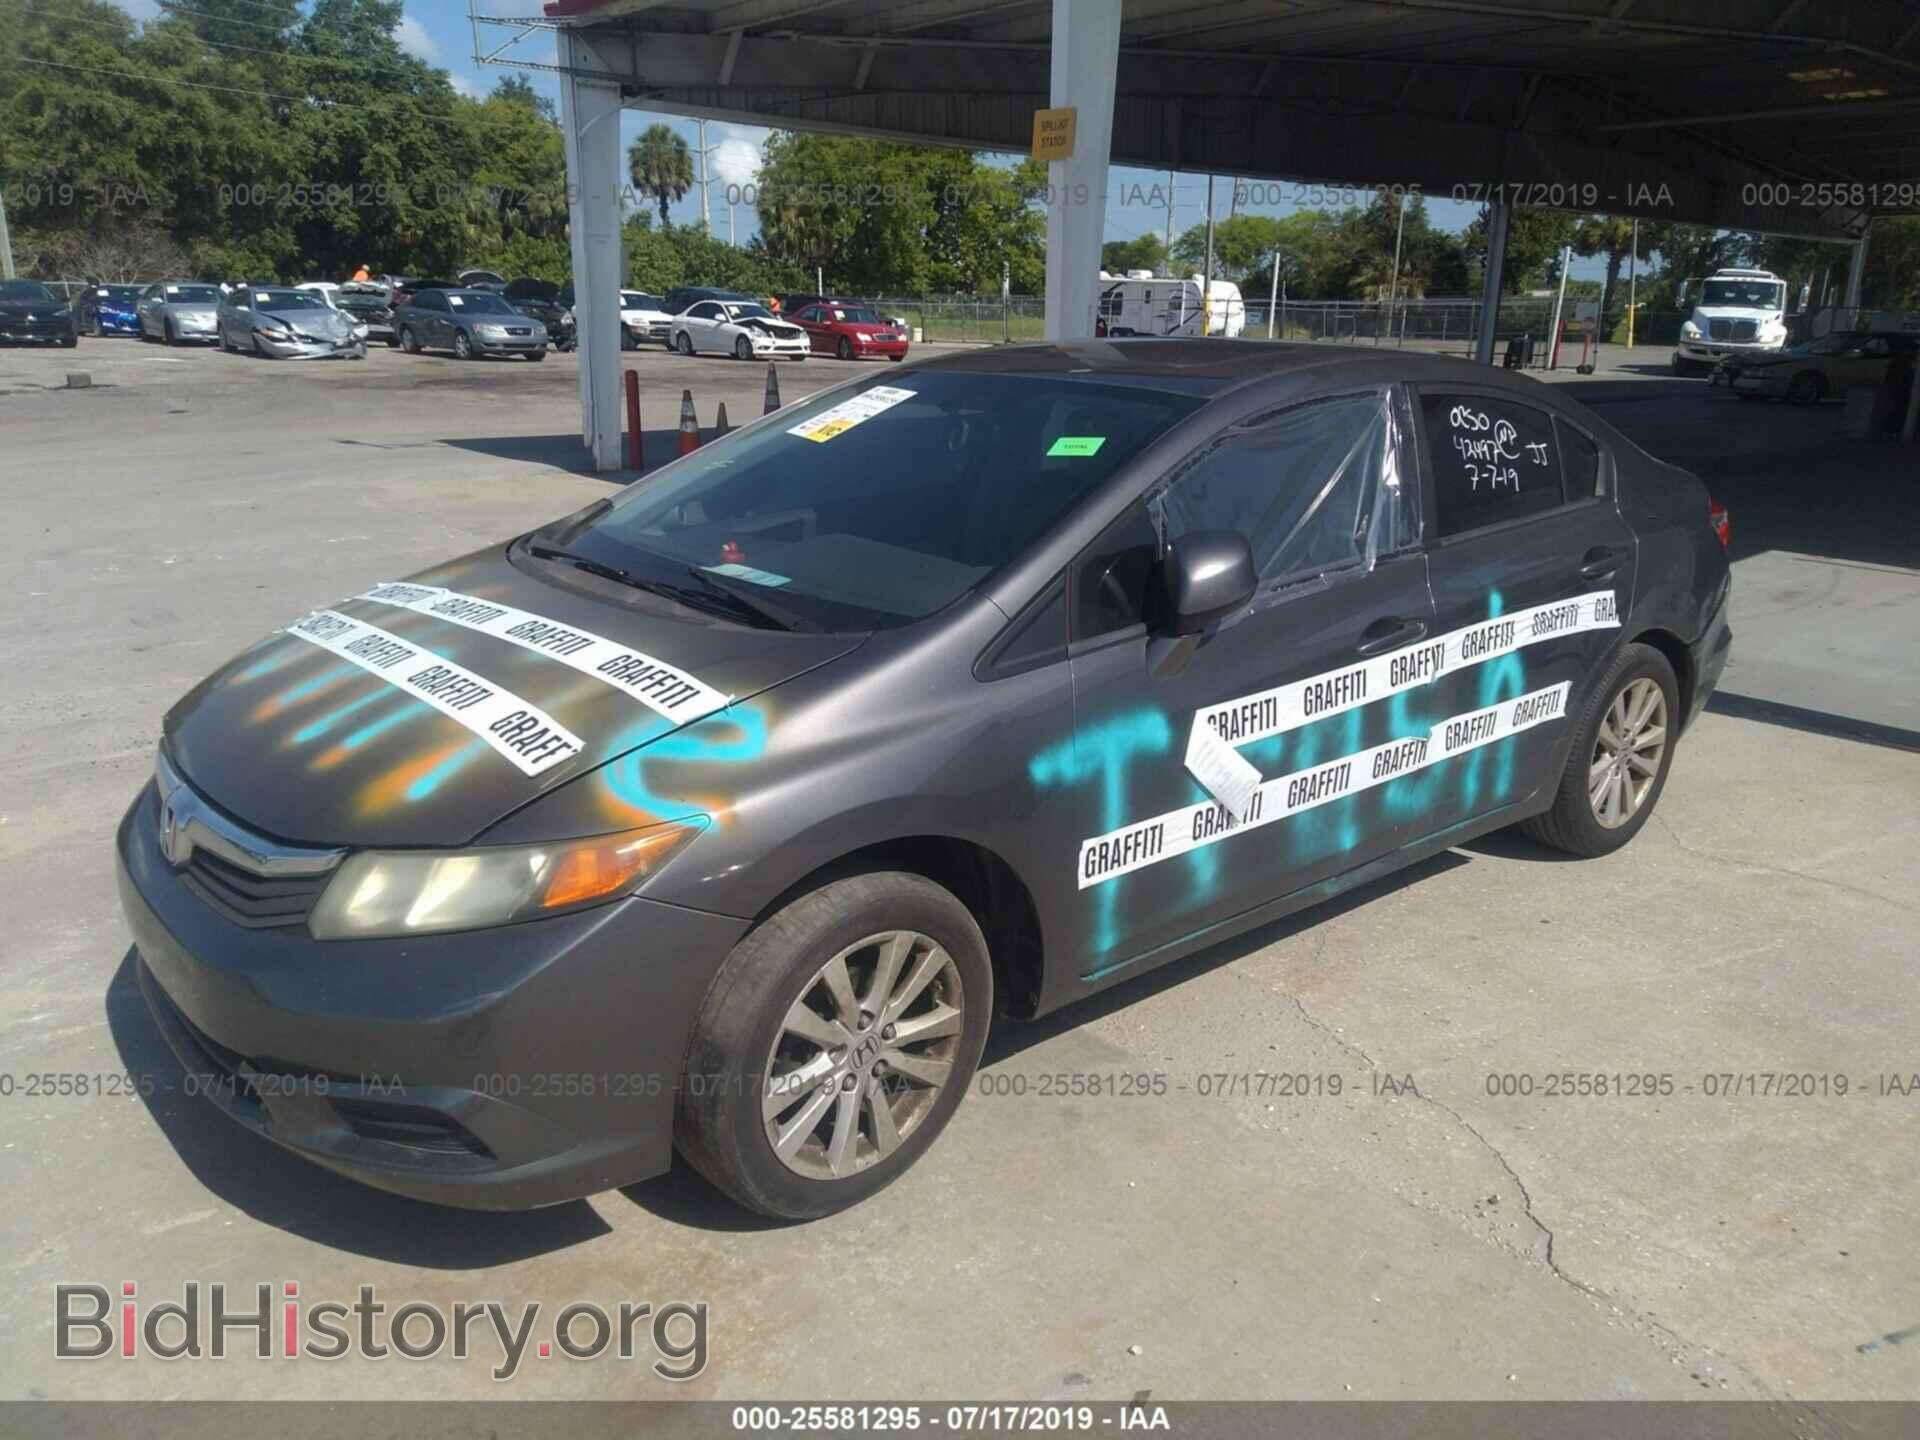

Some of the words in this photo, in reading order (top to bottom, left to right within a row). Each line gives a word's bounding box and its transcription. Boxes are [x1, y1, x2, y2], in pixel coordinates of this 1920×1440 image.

[1464, 464, 1519, 492] 7-7-19
[505, 620, 595, 656] GRAFFITI
[597, 654, 701, 709] GRAFFITI
[1304, 668, 1367, 717] GRAFFITI
[1462, 621, 1515, 660] GRAFFITI
[407, 665, 494, 710] GRAFFITI
[489, 711, 578, 764] GRAFF
[1085, 824, 1163, 878] GRAFFITI
[1288, 762, 1351, 809] GRAFFITI
[1445, 711, 1498, 752] GRAFFITI
[1512, 690, 1562, 727] GRAFFITI
